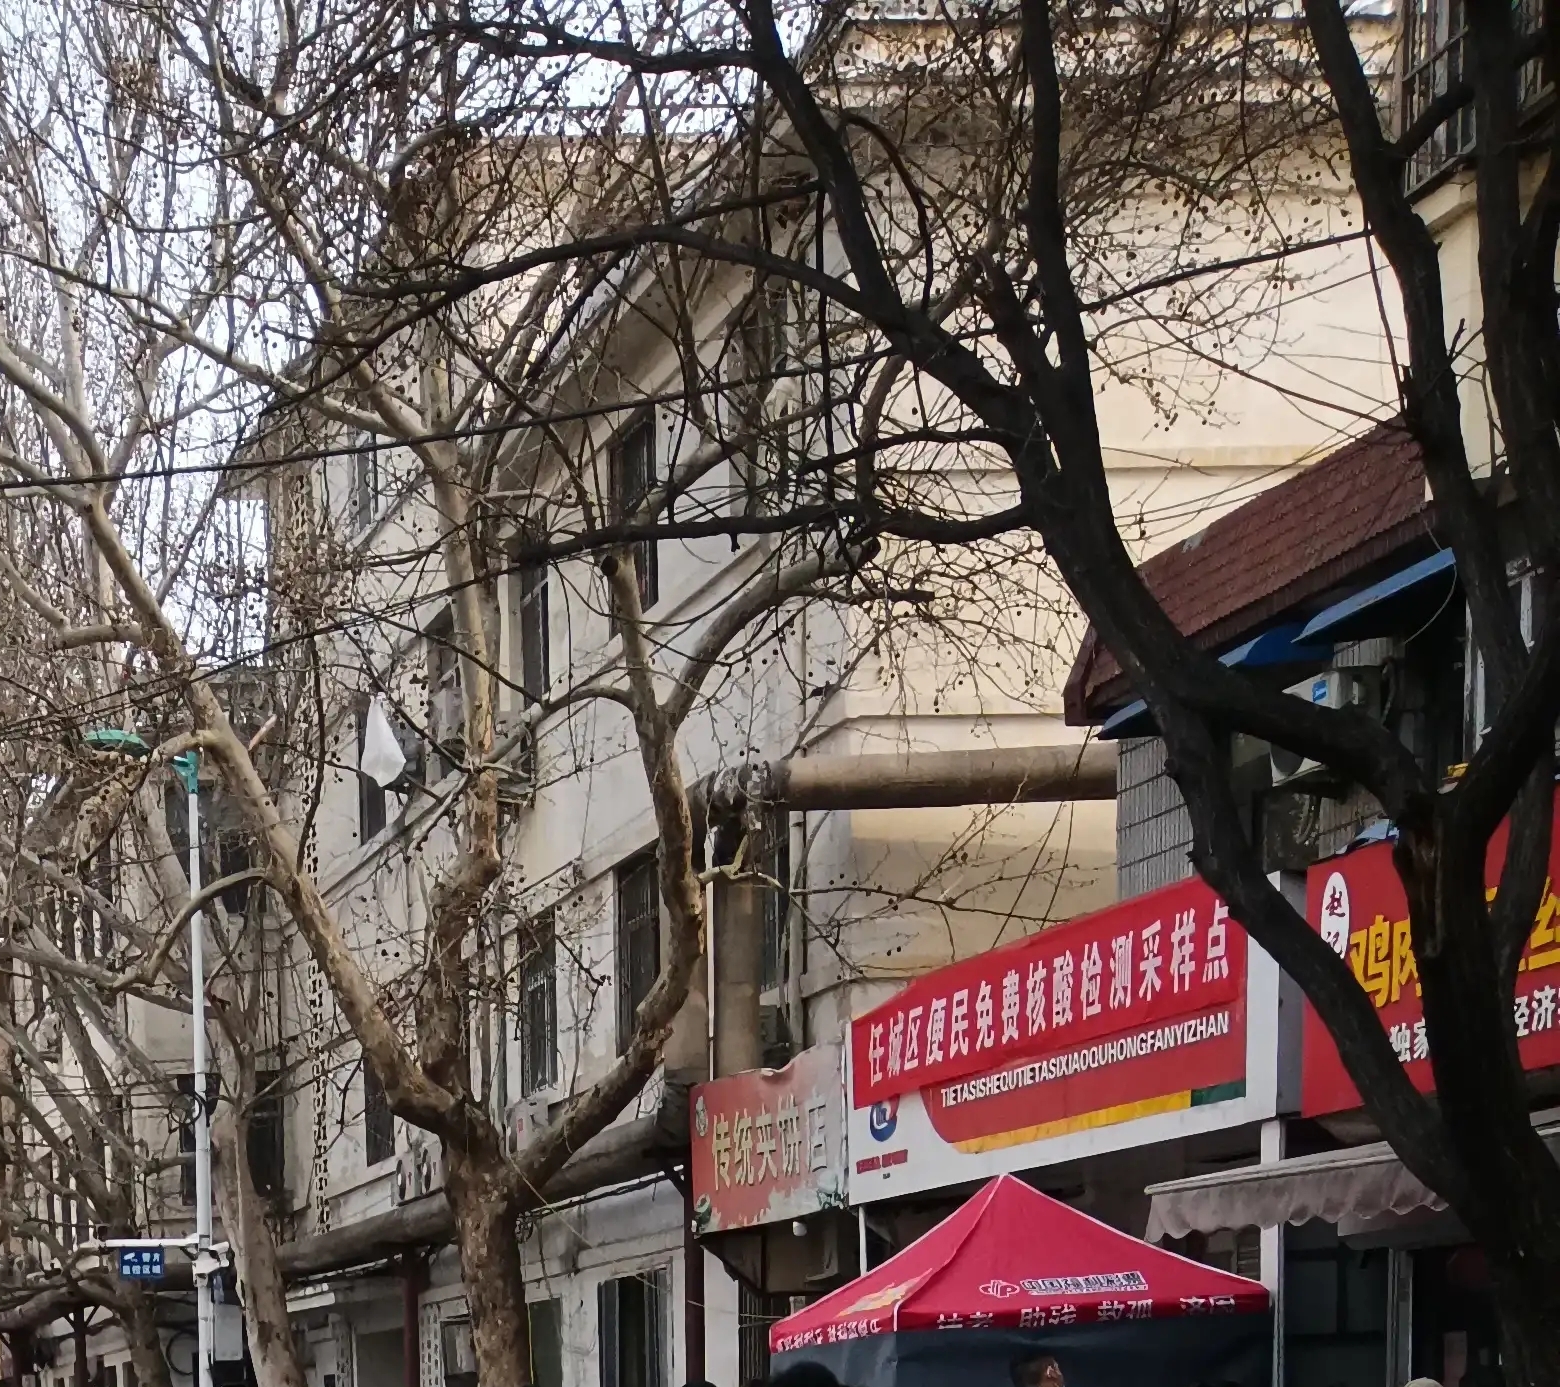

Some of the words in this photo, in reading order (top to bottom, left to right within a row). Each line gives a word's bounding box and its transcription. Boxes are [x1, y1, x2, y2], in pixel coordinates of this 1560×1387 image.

[868, 899, 1229, 1087] 任城区便民免费核酸检测采样点
[1514, 984, 1560, 1038] 经济
[712, 1088, 828, 1191] 传统夹饼店
